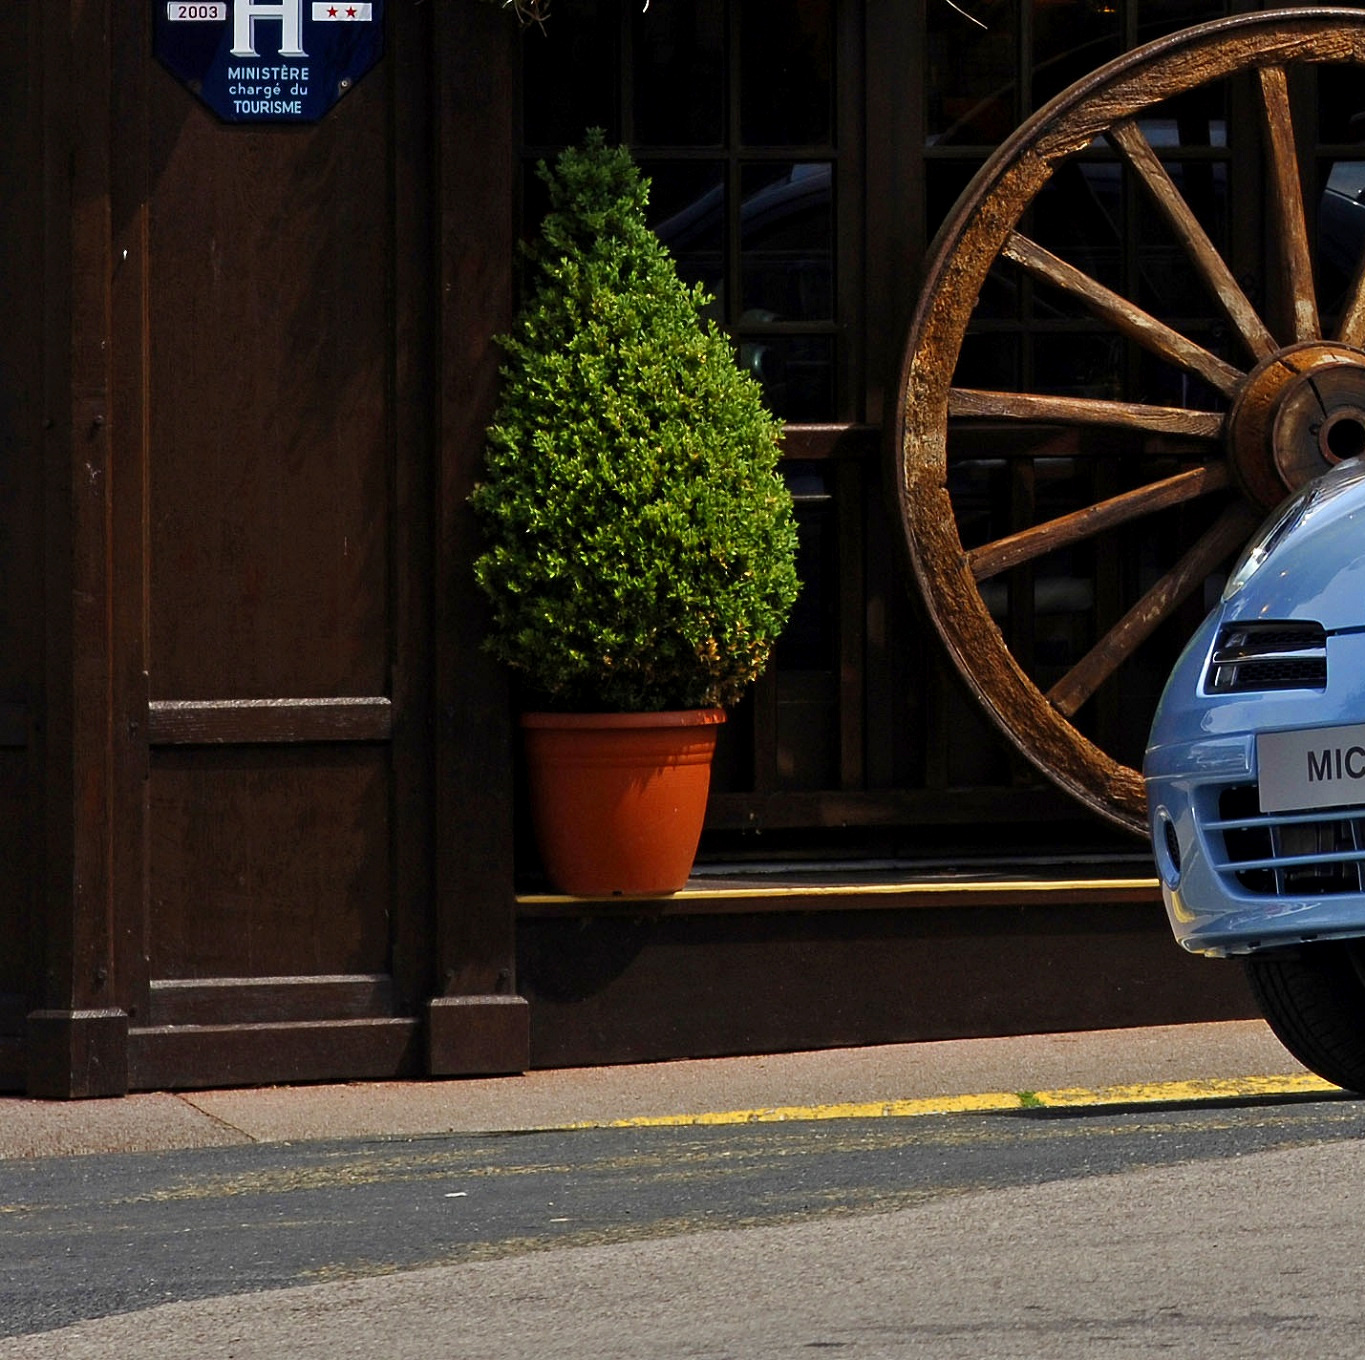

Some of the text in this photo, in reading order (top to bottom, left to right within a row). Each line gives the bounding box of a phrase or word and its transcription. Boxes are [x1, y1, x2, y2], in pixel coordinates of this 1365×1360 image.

[177, 4, 219, 20] 2003
[227, 64, 310, 81] MINISTÈRE
[228, 82, 309, 99] chargé du
[233, 100, 302, 115] TOURISME
